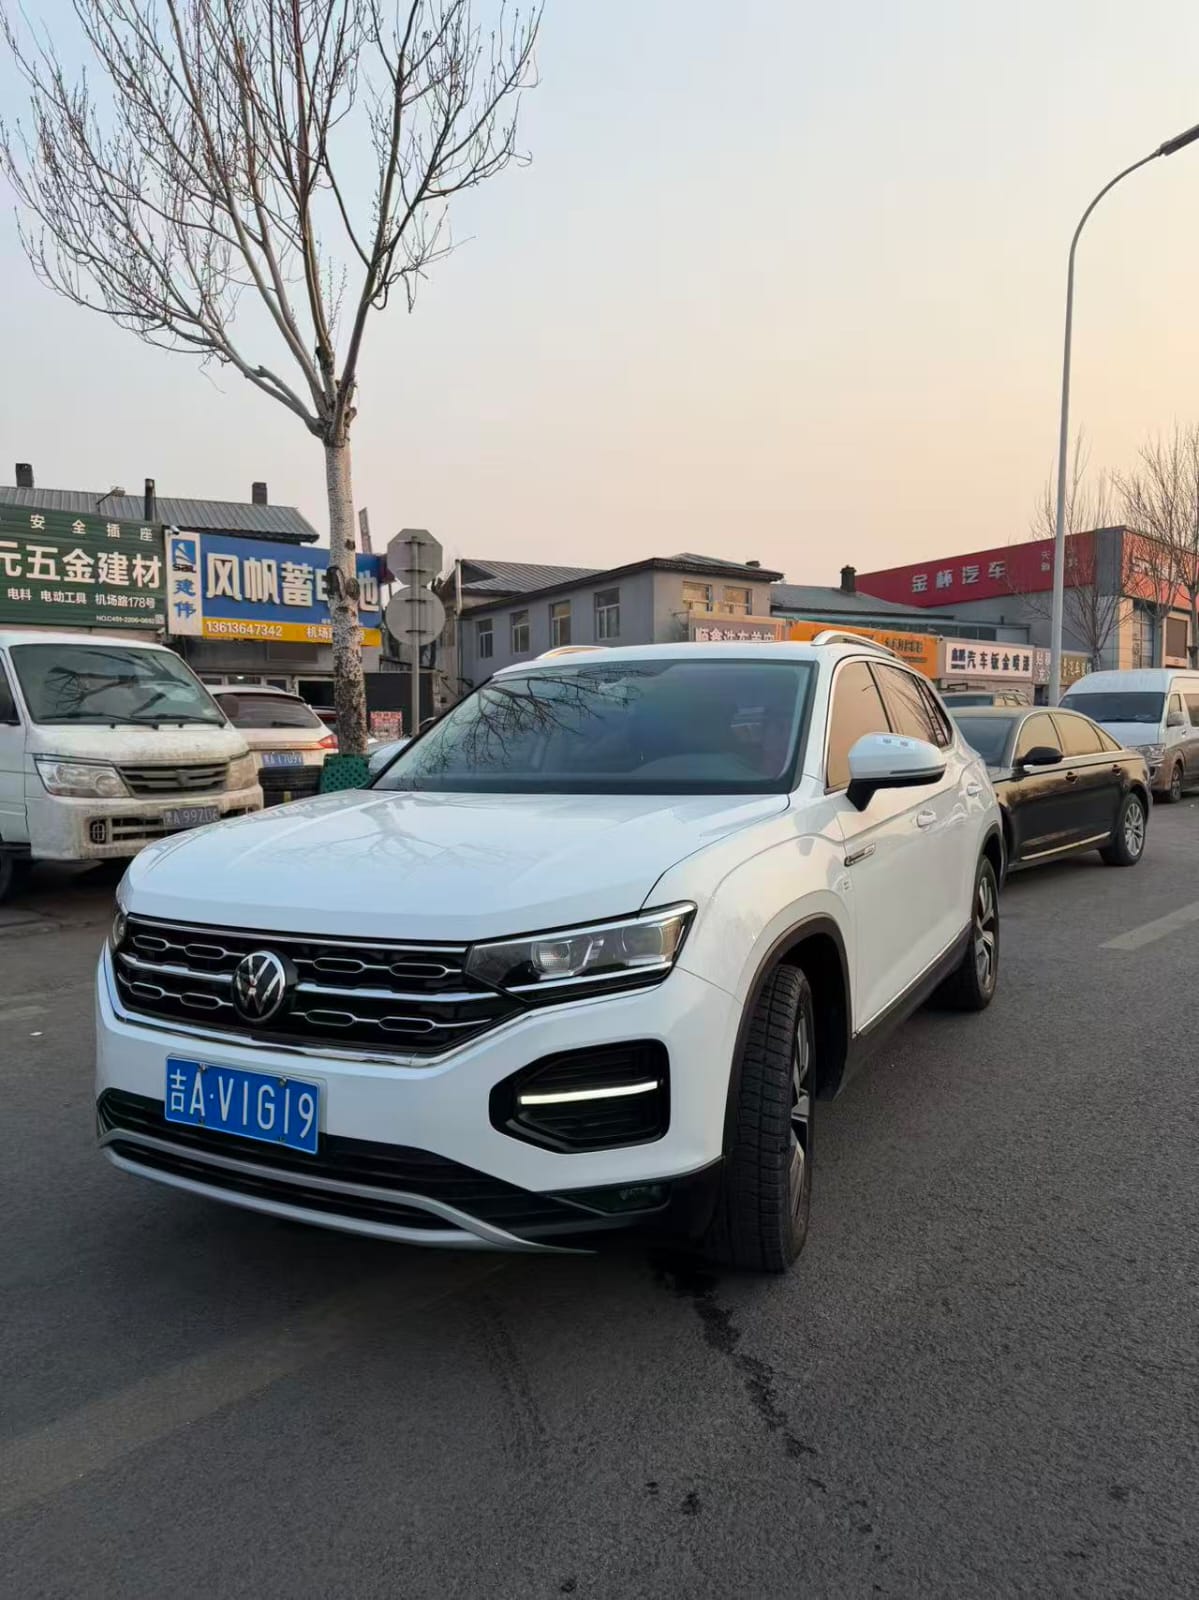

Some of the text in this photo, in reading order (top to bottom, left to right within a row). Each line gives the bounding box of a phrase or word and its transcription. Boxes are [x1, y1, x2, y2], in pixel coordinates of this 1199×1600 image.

[30, 514, 153, 541] 安全插座
[0, 541, 162, 588] 元五金建材
[911, 561, 1008, 593] 金杯汽车
[7, 587, 156, 609] 电料 电动工具 机场路178号
[206, 620, 282, 637] 13613647342
